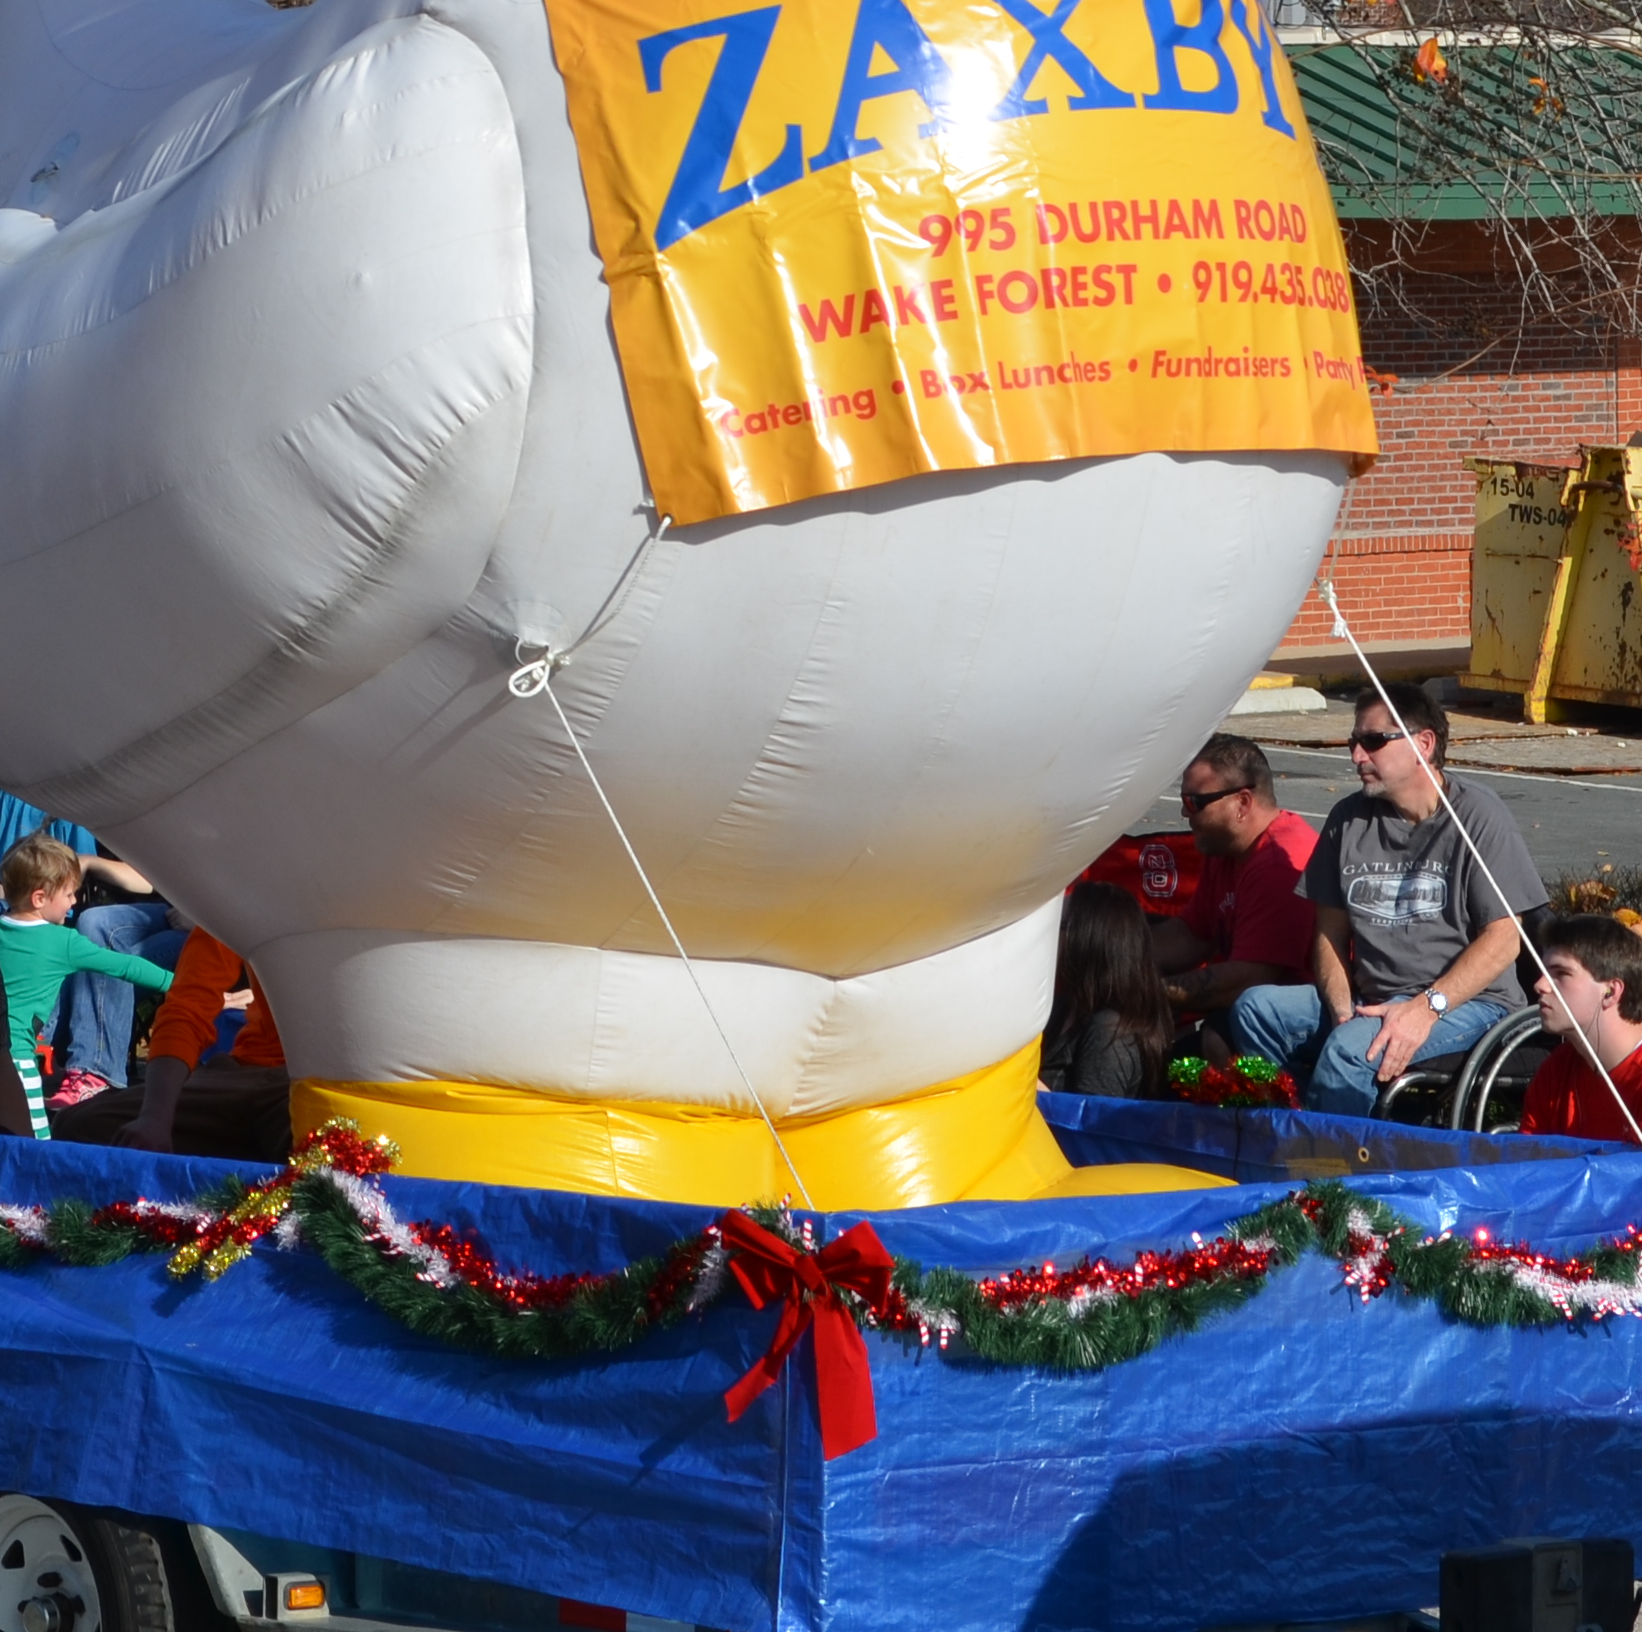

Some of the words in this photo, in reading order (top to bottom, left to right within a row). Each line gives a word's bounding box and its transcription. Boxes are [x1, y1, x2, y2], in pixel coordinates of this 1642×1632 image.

[918, 207, 1017, 258] 995
[1035, 198, 1225, 245] DURHAM
[1233, 199, 1307, 244] ROAD
[798, 278, 959, 343] WAKE
[974, 264, 1138, 316] FOREST
[719, 388, 878, 439] Catering
[919, 368, 991, 399] Box
[998, 351, 1111, 390] Lunches
[1151, 345, 1292, 379] Fundraisers
[1312, 350, 1356, 390] Party
[1490, 477, 1535, 499] 15-04
